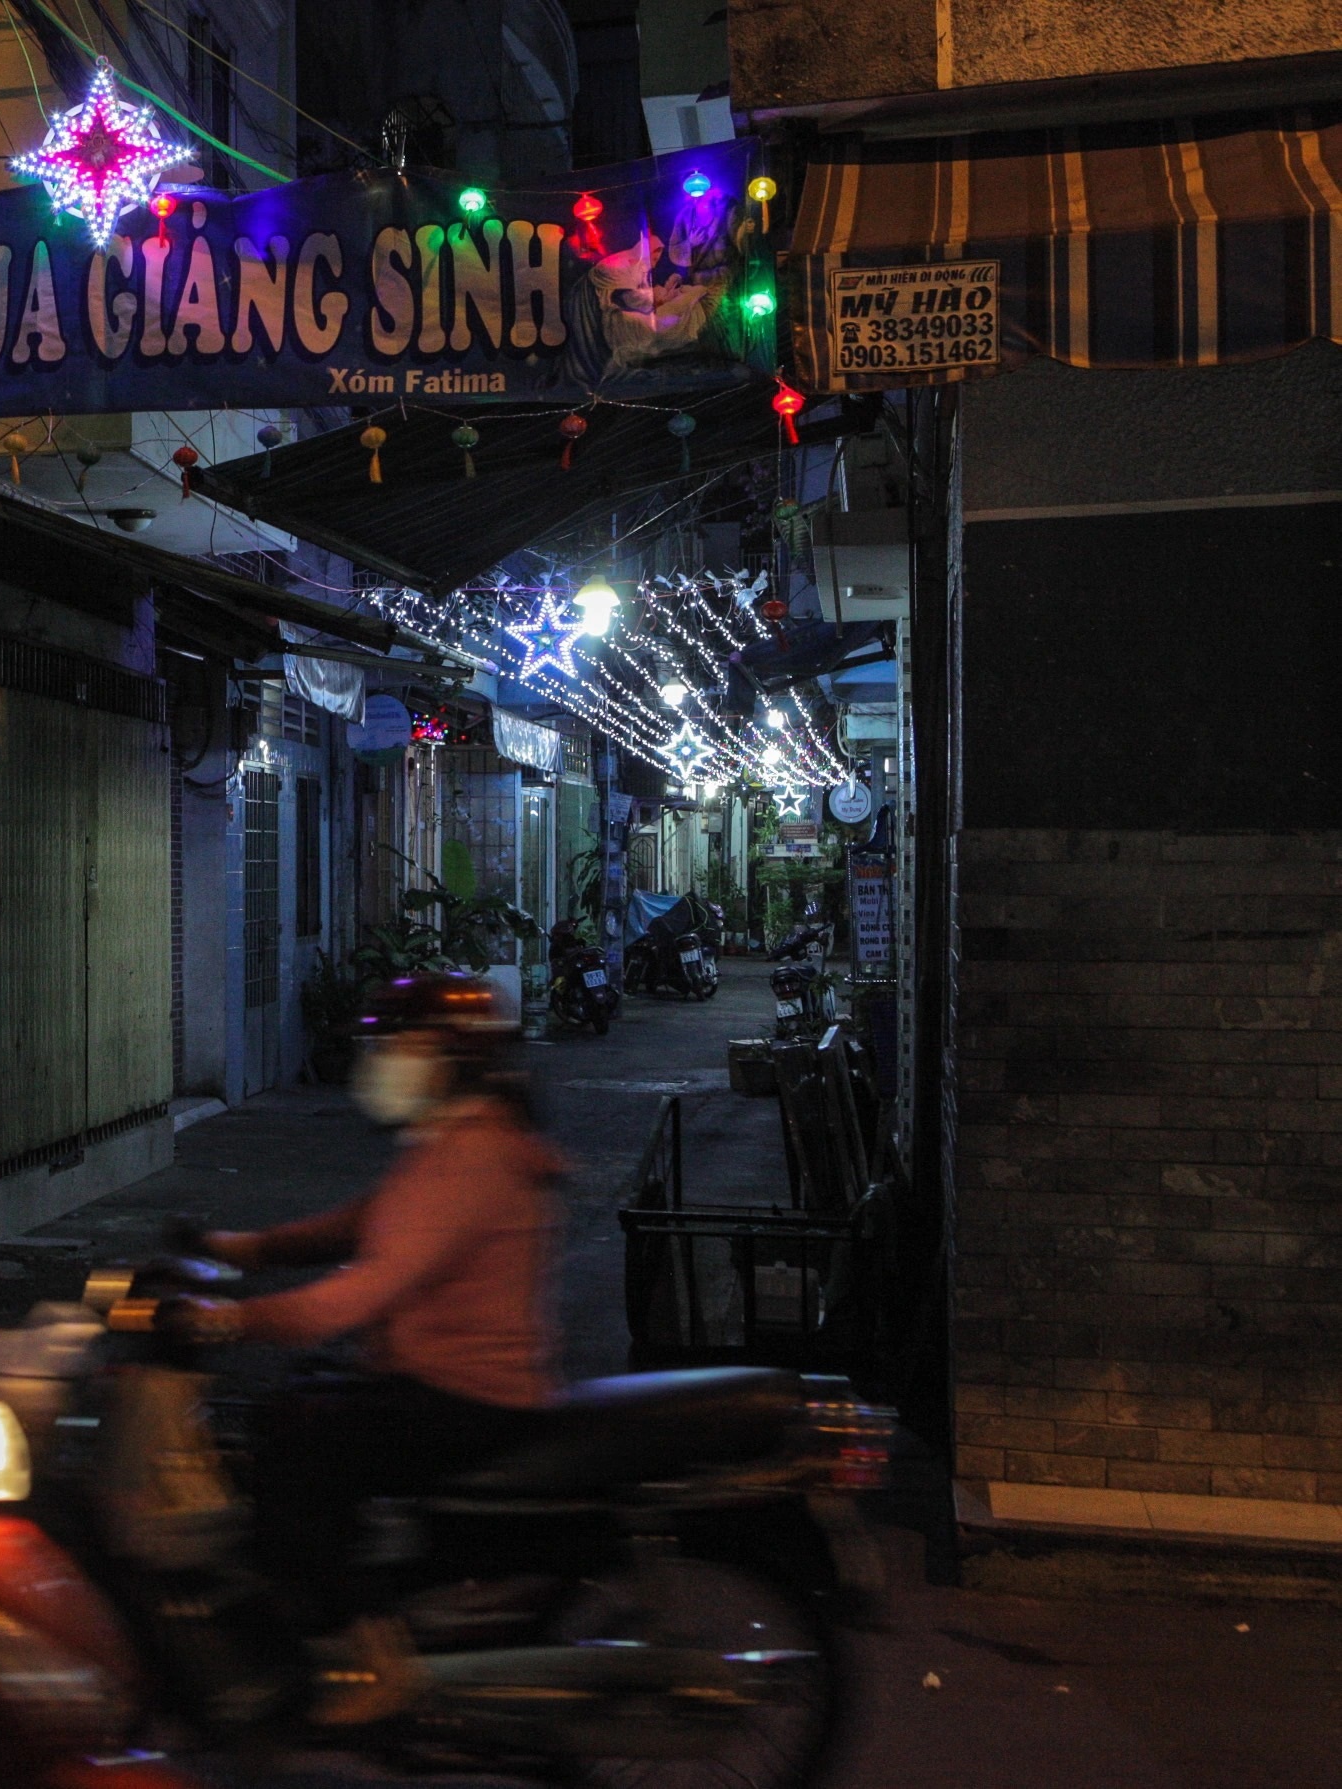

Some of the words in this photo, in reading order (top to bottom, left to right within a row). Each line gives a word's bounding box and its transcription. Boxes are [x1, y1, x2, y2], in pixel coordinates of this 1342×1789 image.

[370, 219, 567, 356] SINH
[840, 287, 899, 318] MỸ
[912, 283, 992, 315] HÀO
[867, 312, 994, 343] 38349033
[840, 337, 993, 368] 0903.151462
[328, 369, 395, 395] Xóm
[405, 369, 507, 395] Fatima
